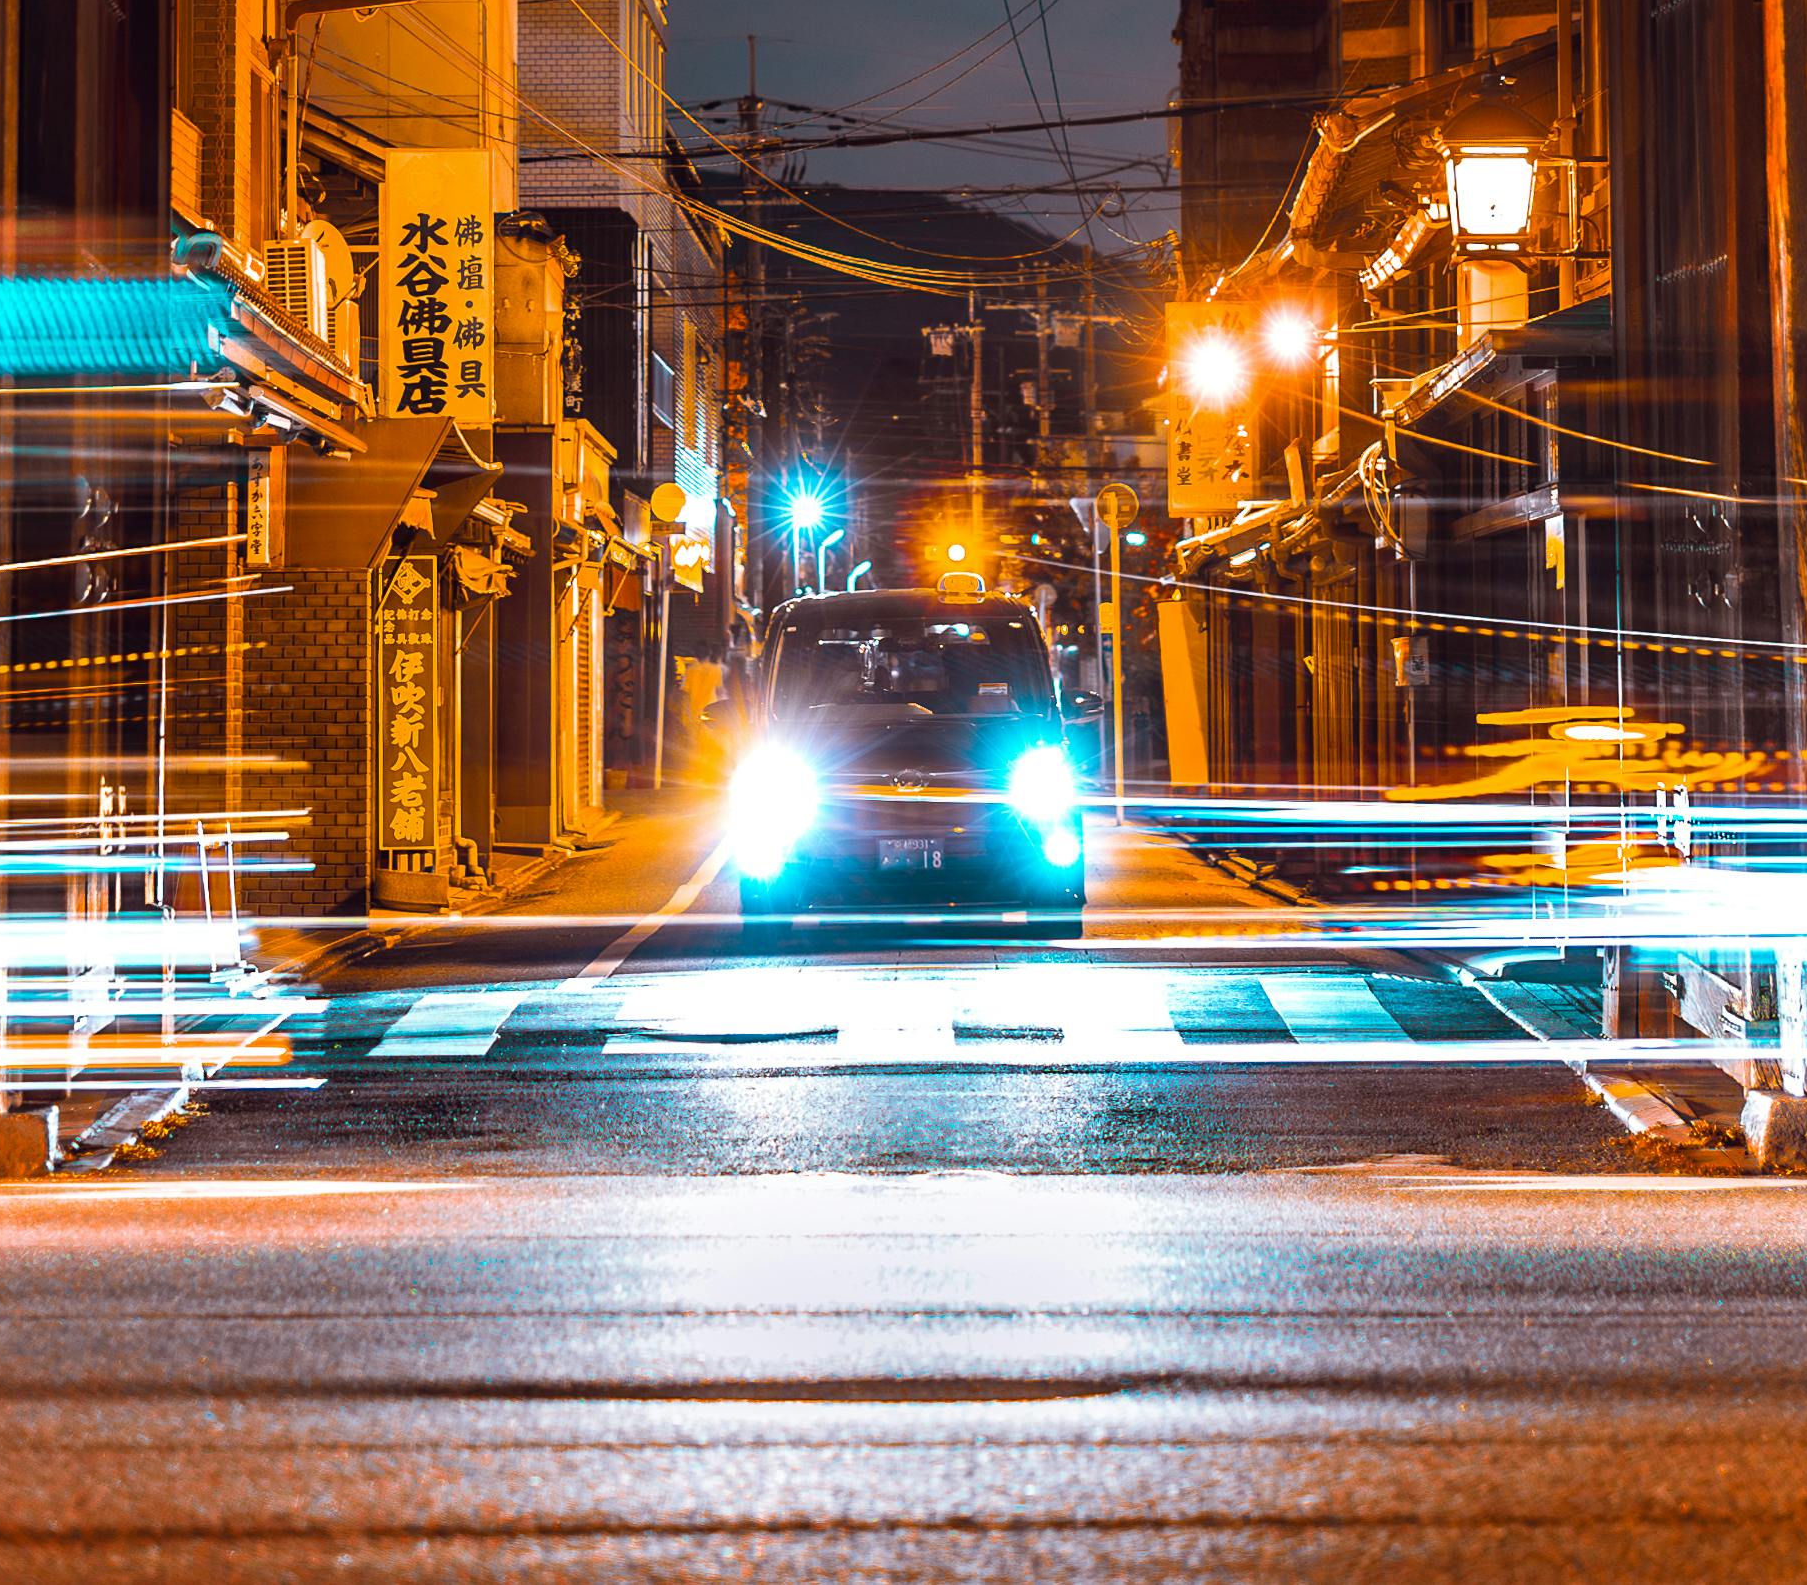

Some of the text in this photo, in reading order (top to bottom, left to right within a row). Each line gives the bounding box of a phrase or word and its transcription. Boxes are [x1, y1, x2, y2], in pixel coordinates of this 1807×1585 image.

[396, 213, 452, 414] 水谷佛具店
